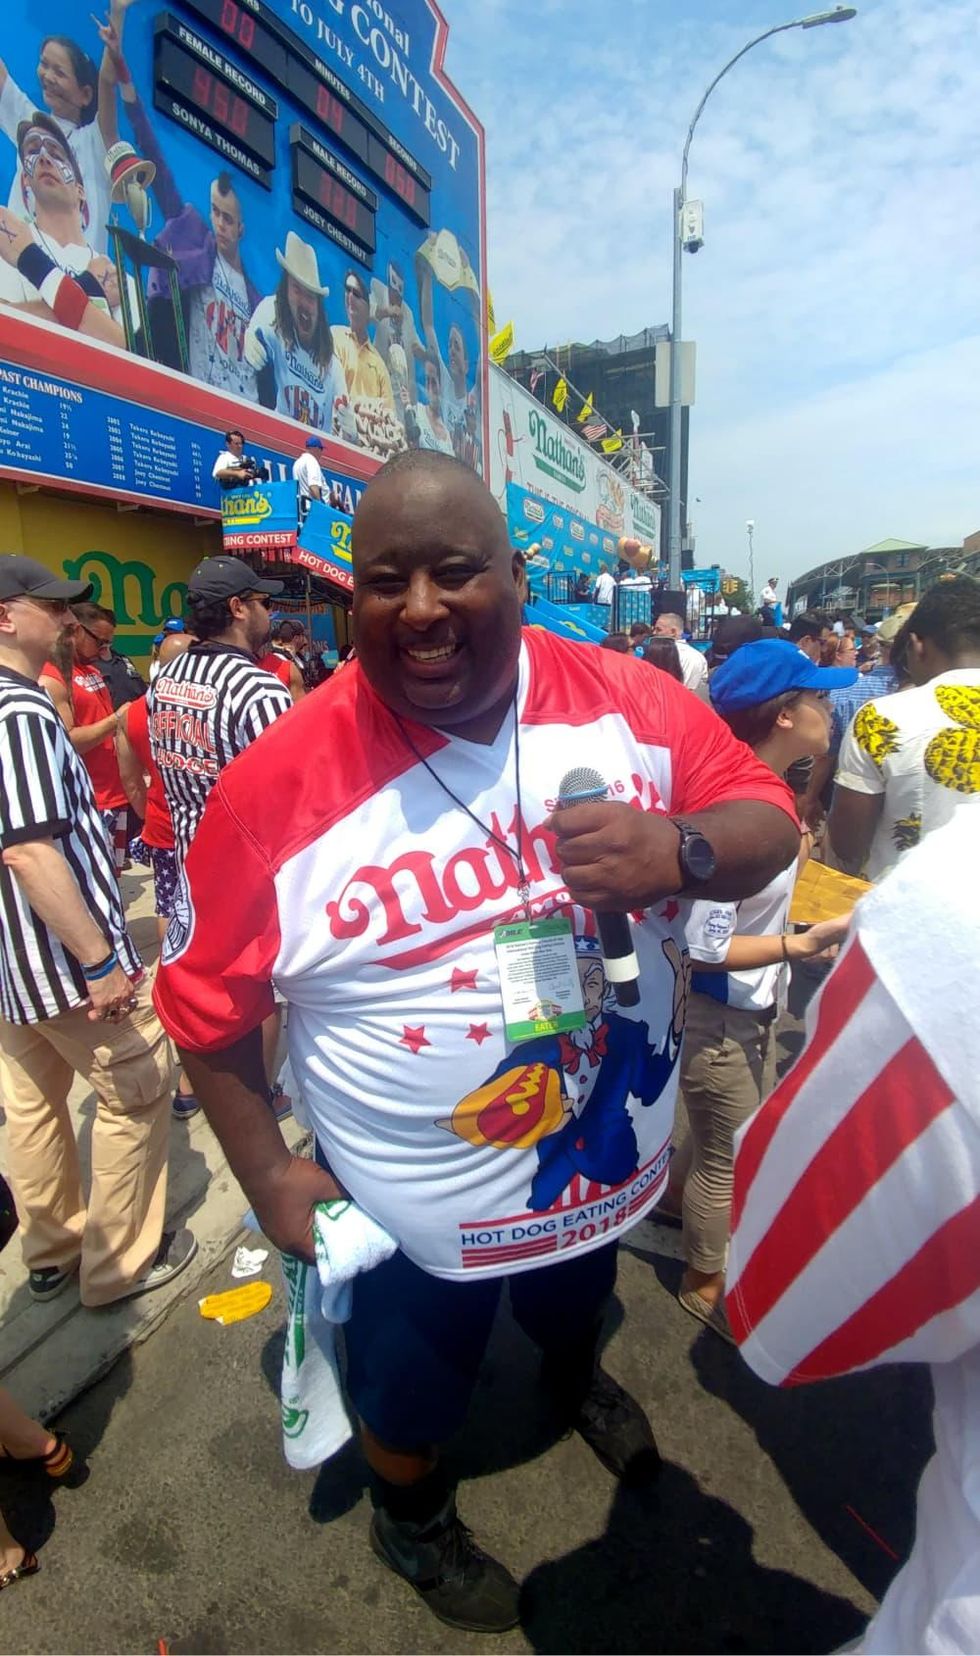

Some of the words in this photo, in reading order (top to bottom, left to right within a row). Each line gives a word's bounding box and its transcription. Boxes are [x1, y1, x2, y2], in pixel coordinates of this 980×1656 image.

[178, 26, 223, 70] FEMALE
[224, 62, 267, 106] RECORD
[314, 58, 351, 100] MINUTES
[317, 18, 354, 67] JULY
[357, 64, 385, 103] 4TH
[351, 4, 460, 172] CONTEST
[171, 102, 213, 142] SONYA
[215, 133, 260, 176] THOMAS
[311, 141, 335, 168] MALE
[335, 161, 367, 198] RECORD
[303, 204, 326, 228] JOEY
[326, 222, 367, 261] CHESTNUT
[22, 375, 83, 404] CHAMPIONS
[6, 448, 42, 462] Kobayashi
[529, 410, 586, 481] Nathan's
[246, 533, 293, 545] CONTEST
[299, 551, 322, 569] HOT
[322, 563, 346, 581] DOG
[156, 679, 214, 702] Nathan's
[153, 711, 216, 755] OFFICIAL
[461, 1231, 505, 1246] HOT
[511, 1219, 557, 1241] DOG
[562, 1193, 627, 1228] EATING
[561, 1208, 630, 1250] 2018
